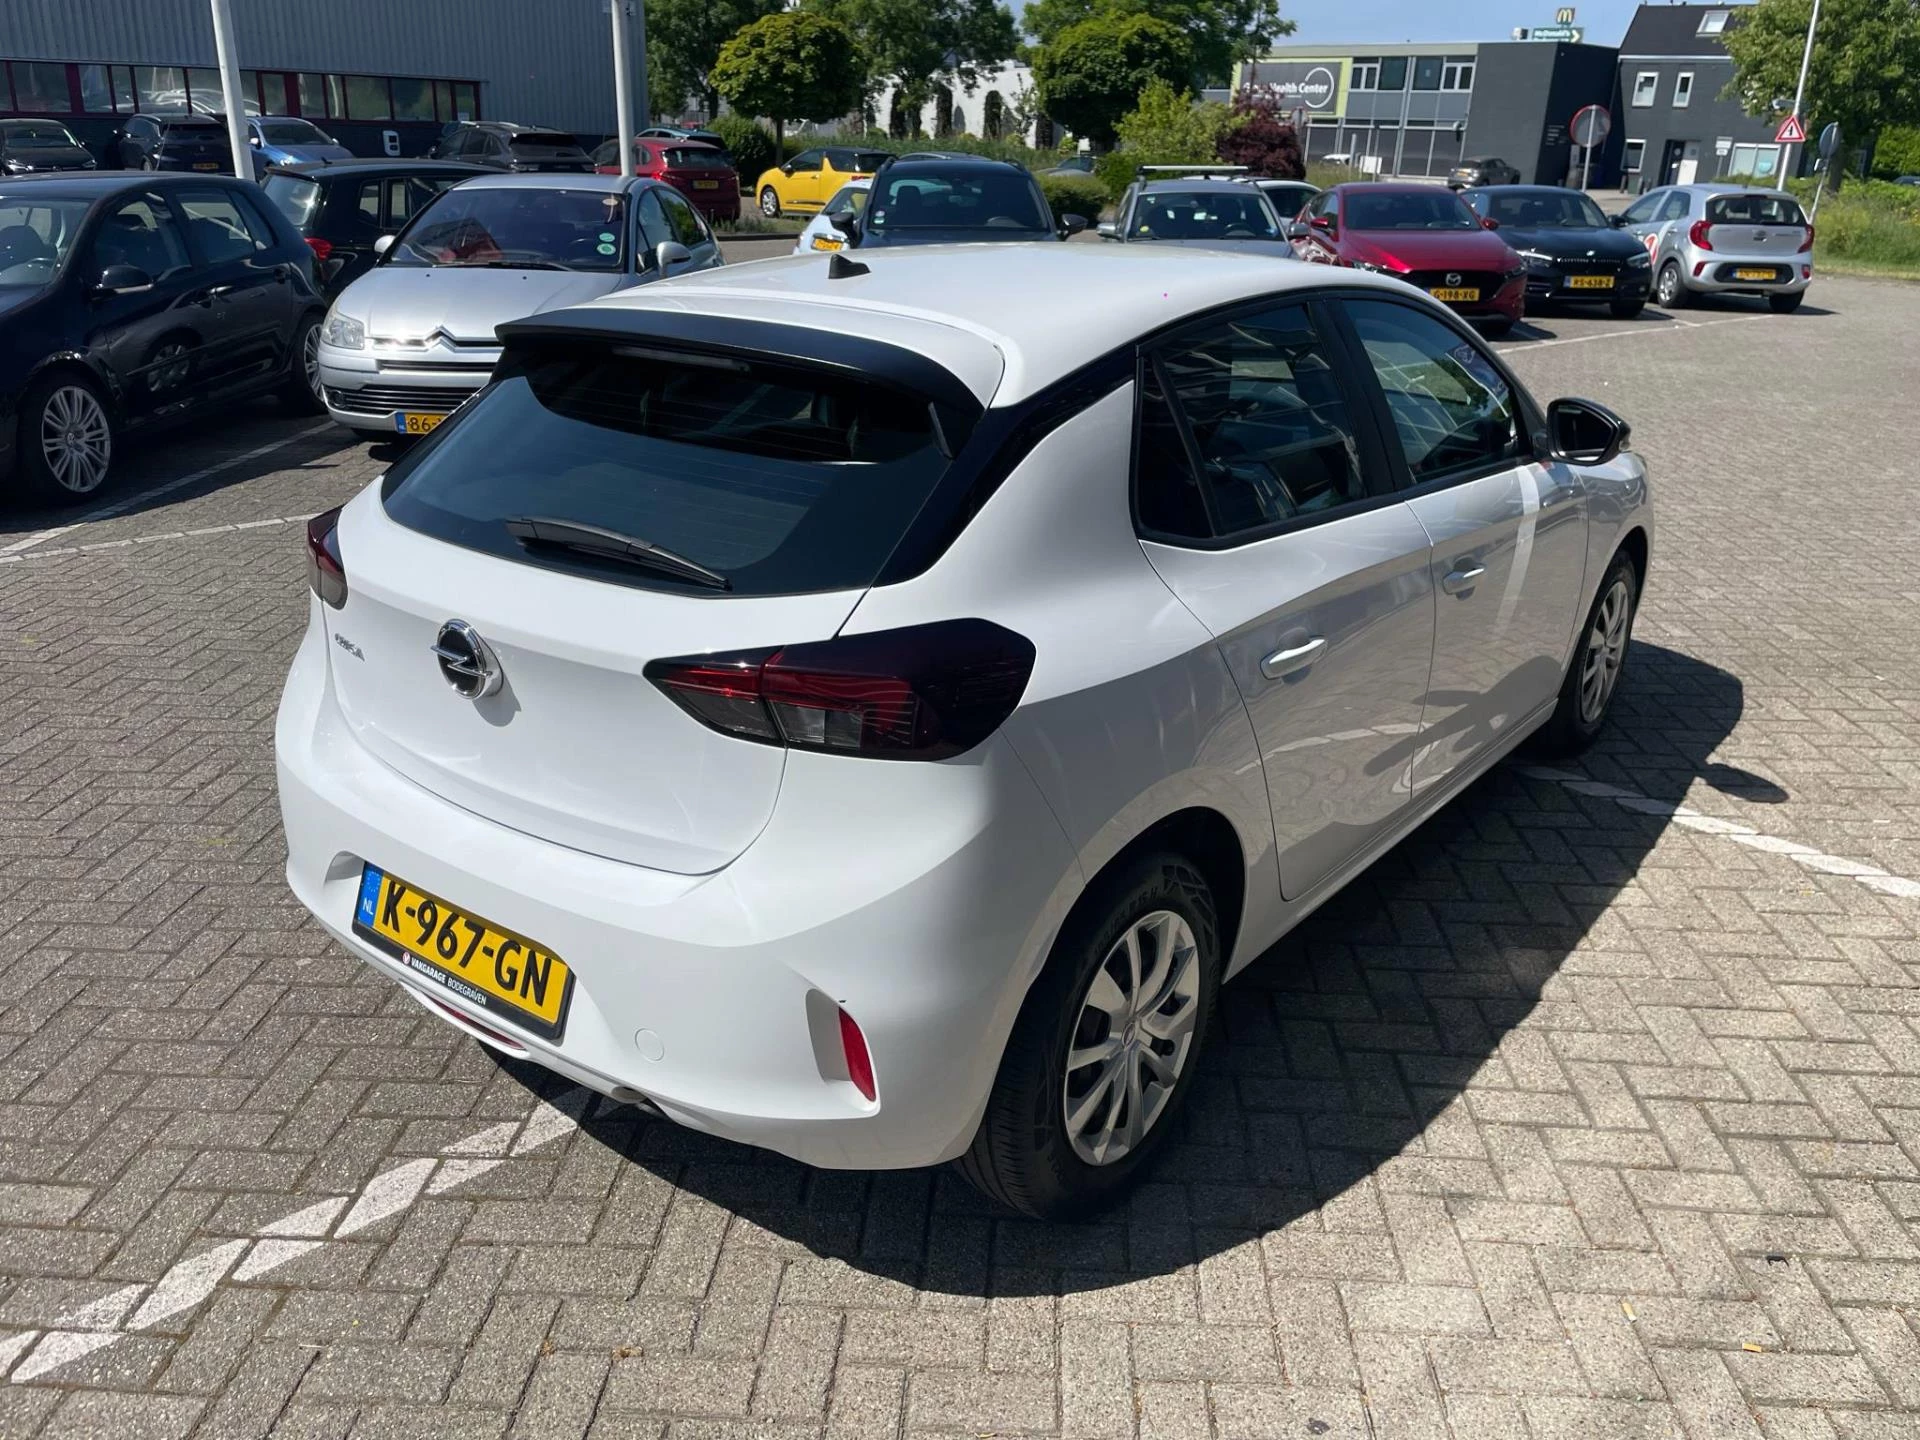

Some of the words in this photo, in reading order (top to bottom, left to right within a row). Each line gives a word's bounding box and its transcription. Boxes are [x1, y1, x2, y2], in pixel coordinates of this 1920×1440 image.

[1298, 82, 1329, 93] Center
[362, 898, 374, 916] NL
[382, 880, 552, 1007] K-967-GN
[411, 956, 446, 984] VAKGARAGE
[447, 976, 488, 1006] BODEGRAVEN
